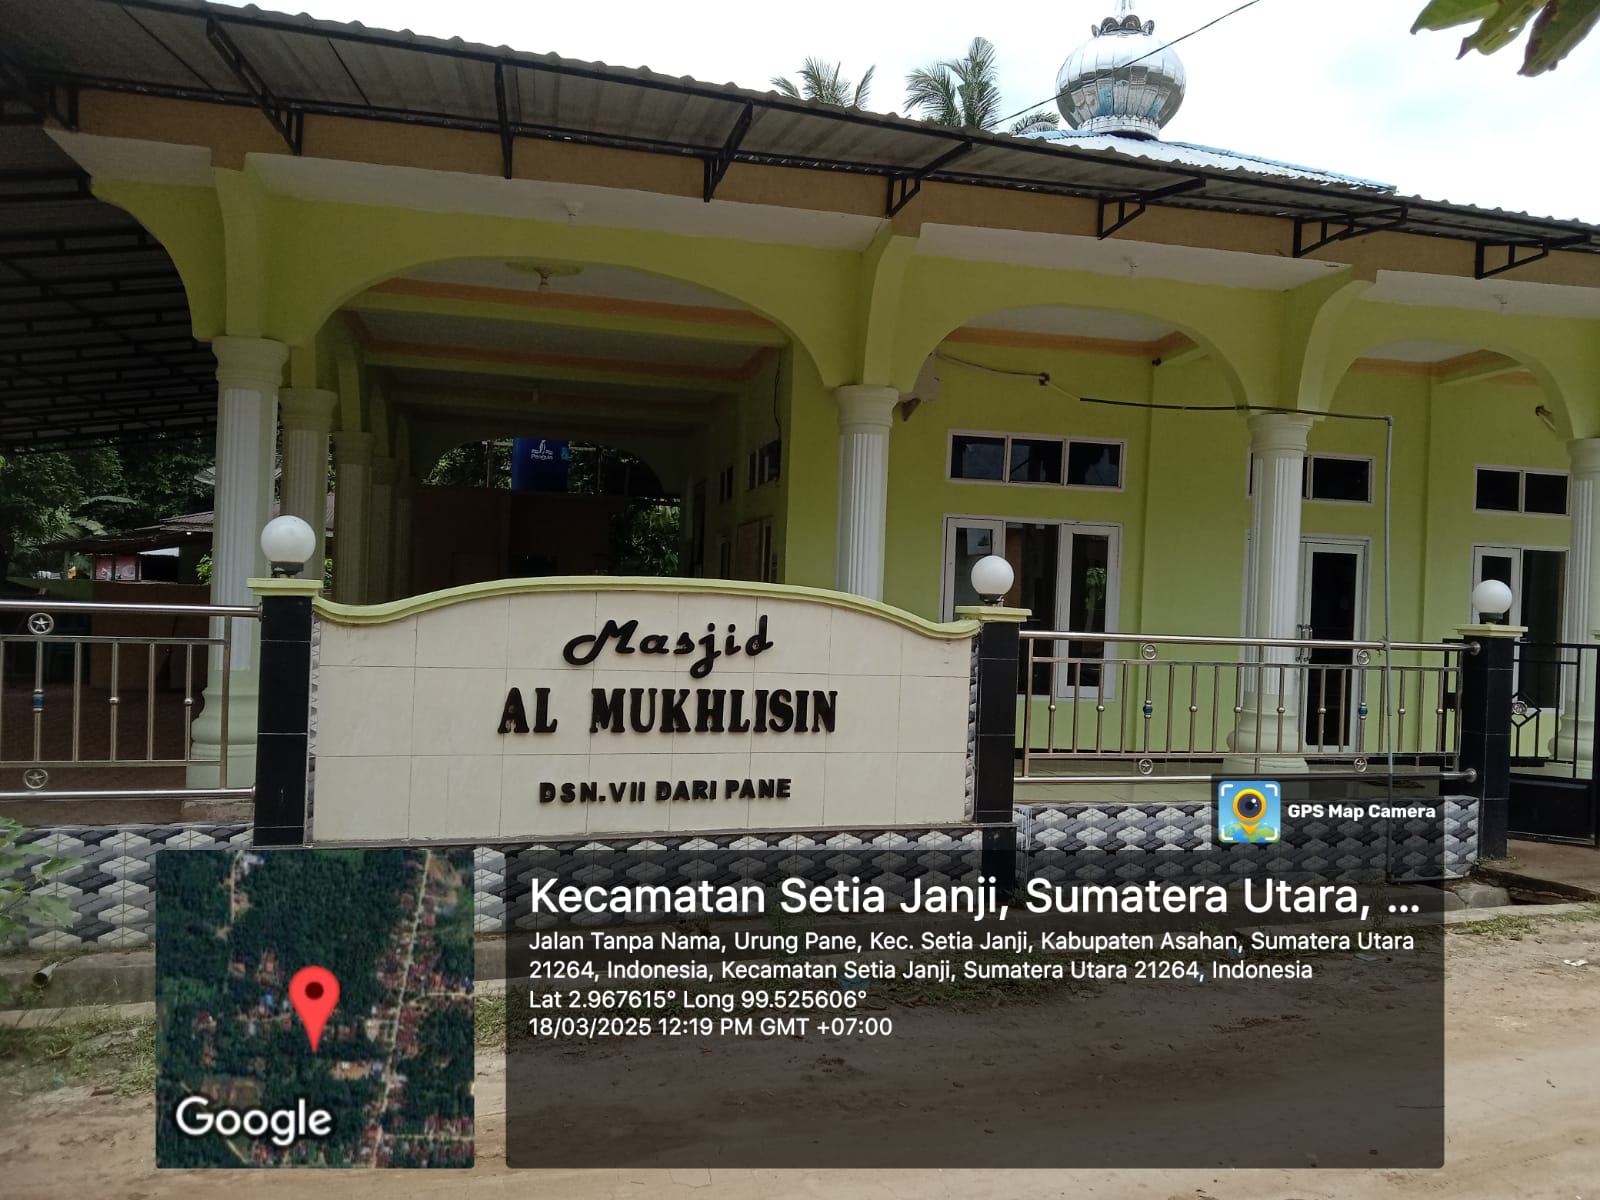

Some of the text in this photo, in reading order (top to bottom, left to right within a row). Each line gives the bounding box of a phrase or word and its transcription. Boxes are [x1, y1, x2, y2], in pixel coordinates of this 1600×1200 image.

[562, 614, 774, 680] Masjid
[497, 687, 838, 735] AL MUKHLISIN
[539, 778, 792, 804] DSN.VII DARI PANE
